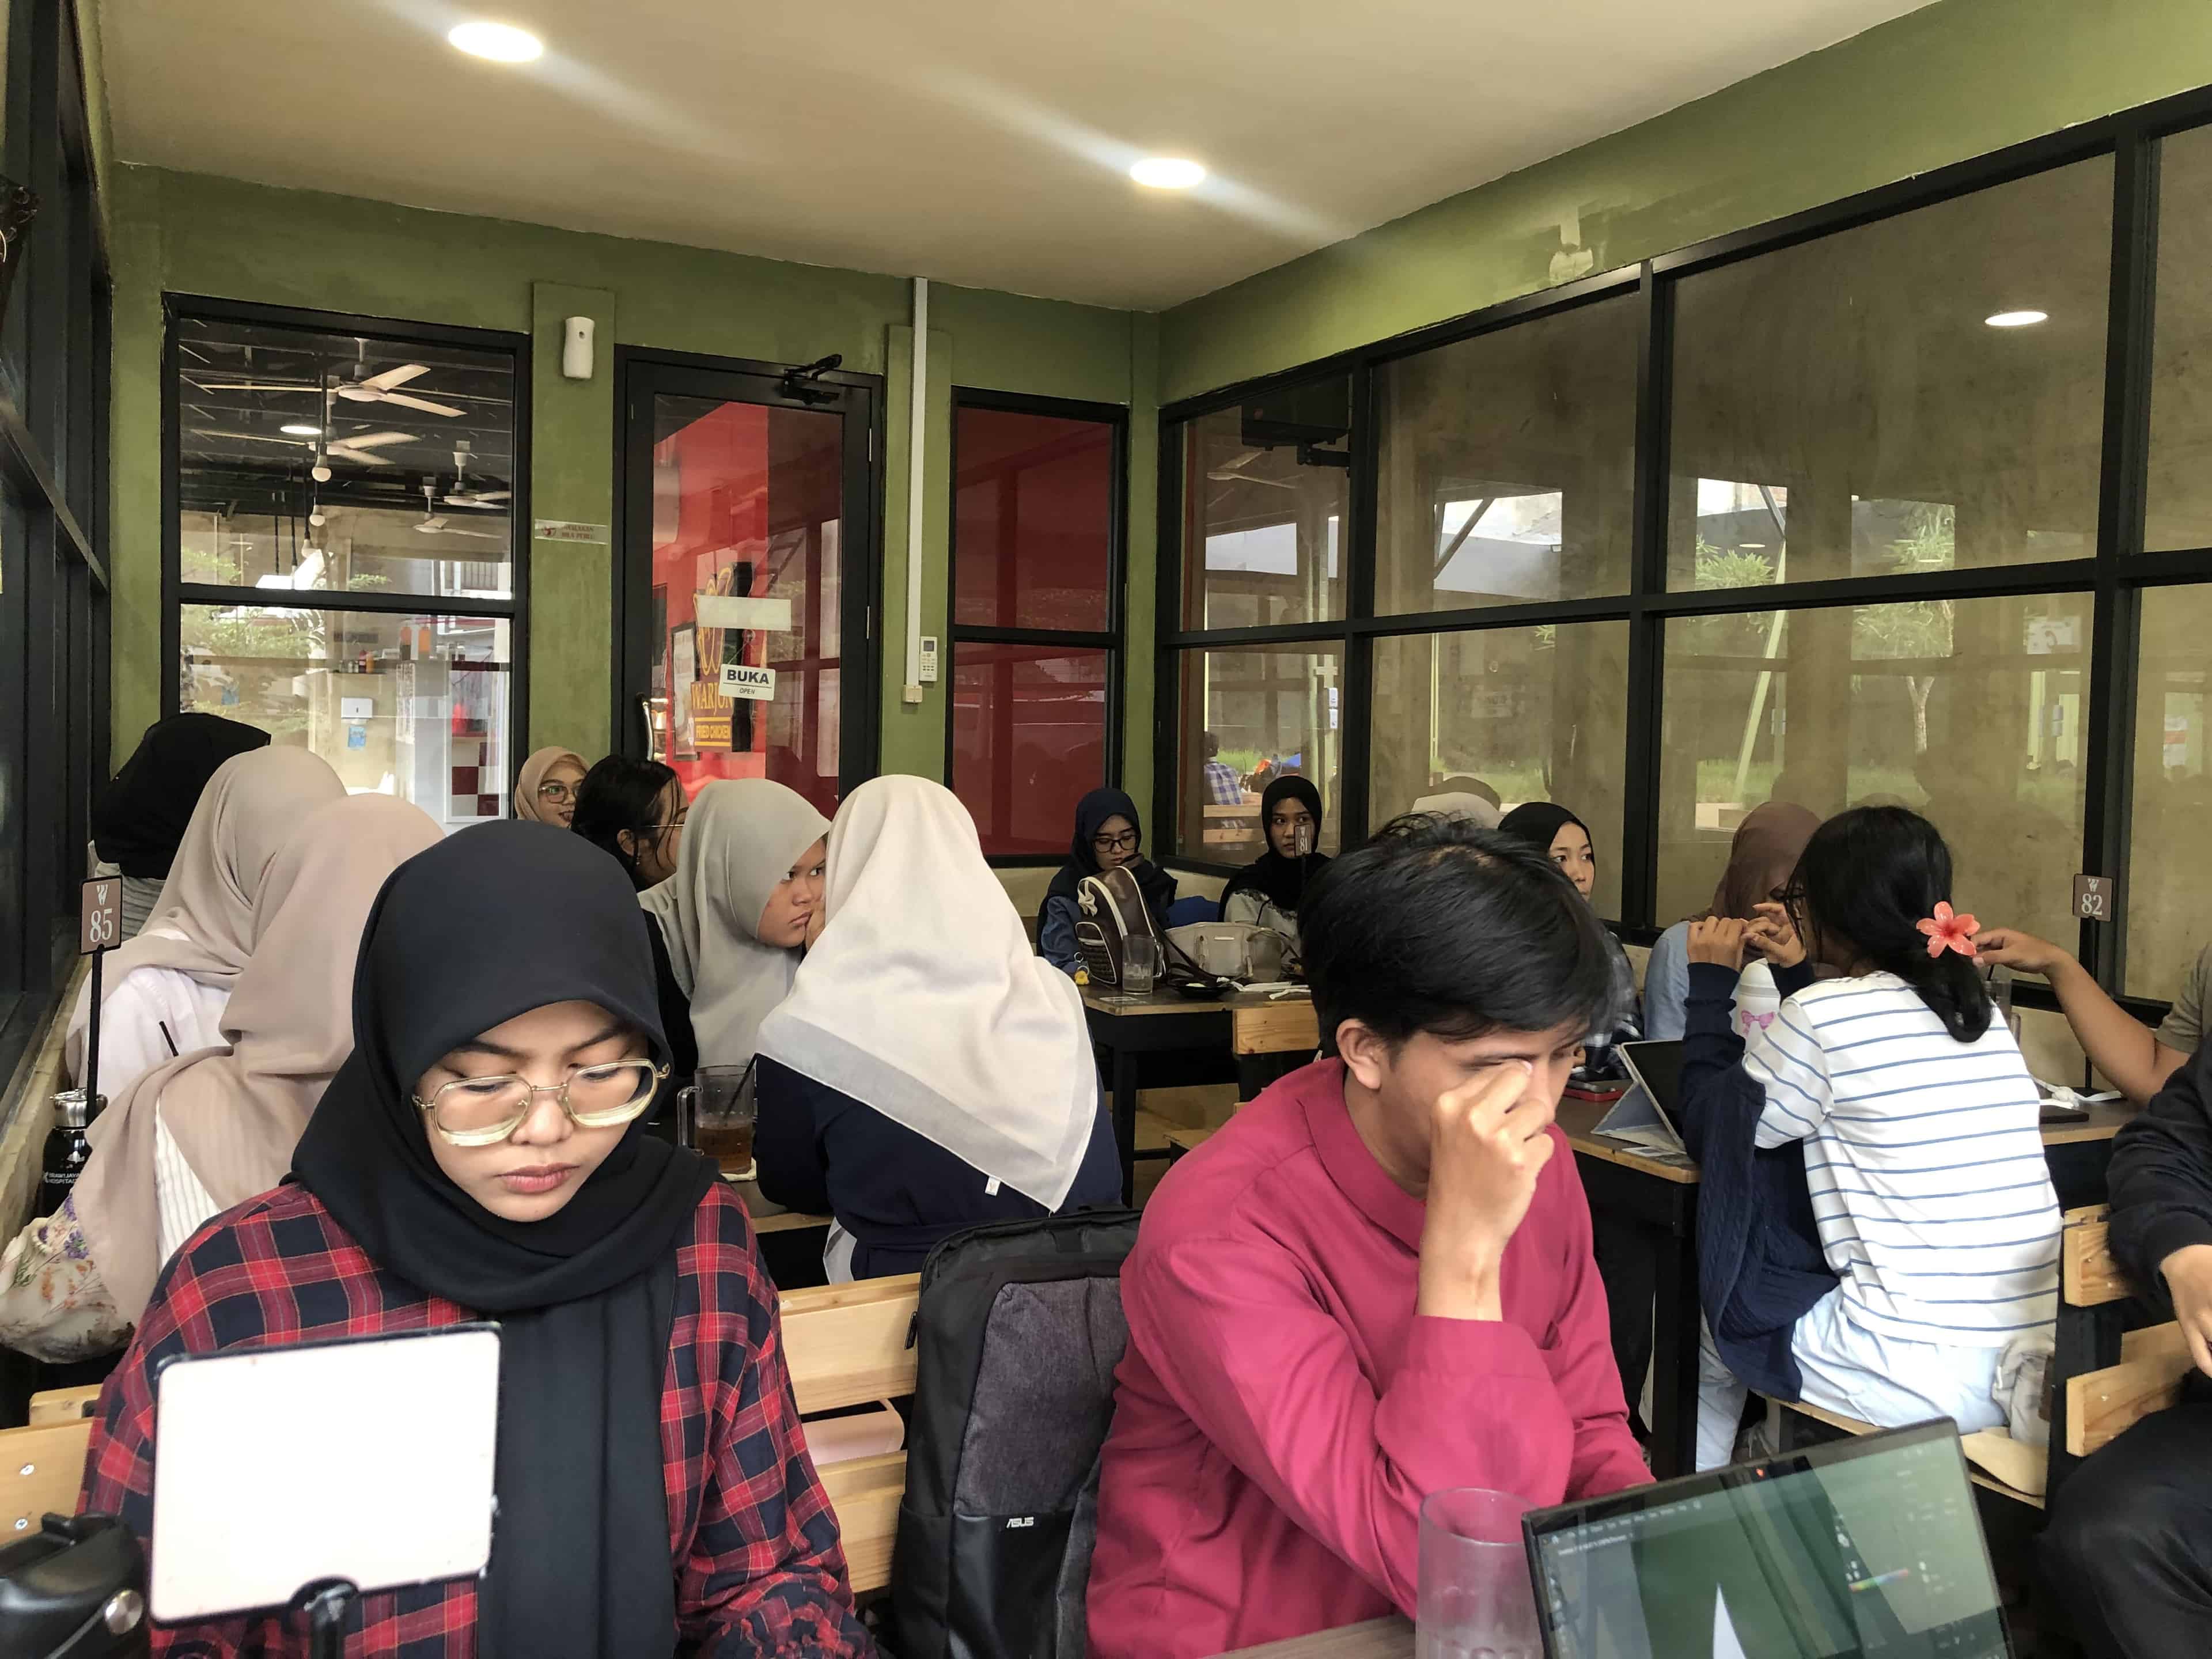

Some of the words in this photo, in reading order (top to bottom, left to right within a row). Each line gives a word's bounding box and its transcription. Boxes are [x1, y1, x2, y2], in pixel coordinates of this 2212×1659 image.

[727, 669, 769, 684] BUKA
[1300, 837, 1308, 852] 81
[2081, 893, 2103, 915] 82
[89, 908, 113, 942] 85
[1006, 1517, 1035, 1529] ASUS
